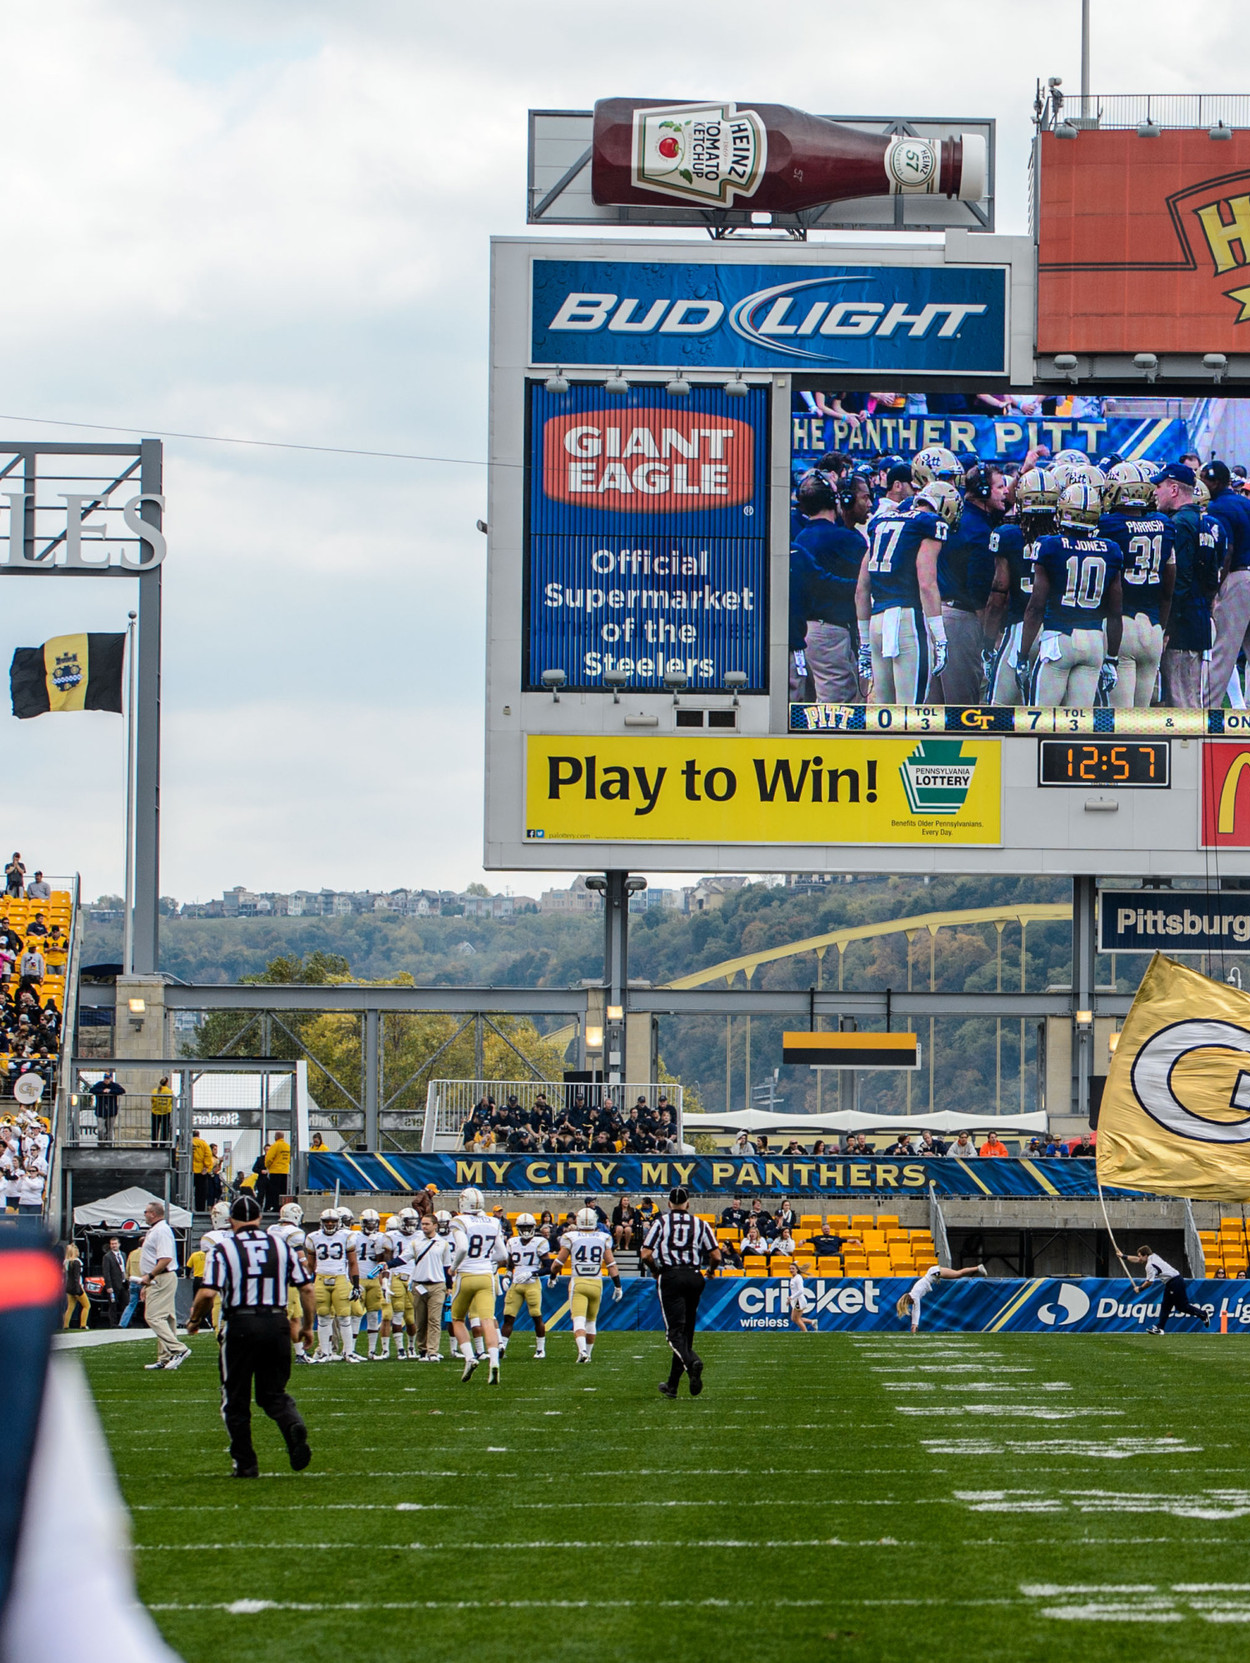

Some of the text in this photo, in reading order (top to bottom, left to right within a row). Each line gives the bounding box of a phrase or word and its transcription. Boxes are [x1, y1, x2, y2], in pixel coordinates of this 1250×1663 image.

[692, 122, 705, 178] KETCHUP
[705, 121, 721, 181] TOMATO
[728, 123, 750, 179] HEINZ
[906, 150, 919, 172] 57
[920, 149, 931, 175] HEINZ
[548, 292, 987, 338] BUD LIGHT
[564, 425, 734, 459] GIANT
[834, 417, 977, 453] PANTHER
[995, 422, 1107, 453] PITT
[921, 454, 941, 467] Pitt
[568, 462, 729, 495] EAGLE
[1125, 520, 1164, 534] PARRISH
[867, 521, 906, 573] 17
[1061, 538, 1108, 552] R. JONES
[591, 550, 707, 575] Official
[1124, 535, 1163, 585] 31
[1061, 556, 1107, 609] 10
[544, 583, 753, 612] Supermarket
[601, 618, 697, 644] of the
[584, 652, 714, 678] Steelers
[803, 705, 855, 730] PITT
[877, 710, 892, 728] 0
[915, 708, 937, 717] TOL
[920, 718, 930, 730] 3
[960, 709, 994, 730] GT
[1027, 711, 1042, 729] 7
[1063, 709, 1086, 718] TOL
[1070, 719, 1079, 730] 3
[1068, 746, 1155, 779] 12:57
[547, 755, 879, 816] Play to Win!
[915, 775, 970, 786] LOTTERY
[456, 1161, 937, 1187] MY CITY. MY PANTHERS.
[467, 1235, 497, 1259] 87
[673, 1224, 691, 1247] U
[243, 1240, 270, 1276] F
[316, 1243, 344, 1261] 33
[575, 1246, 603, 1263] 48
[740, 1317, 789, 1328] wireless
[1097, 1298, 1214, 1323] Duquse
